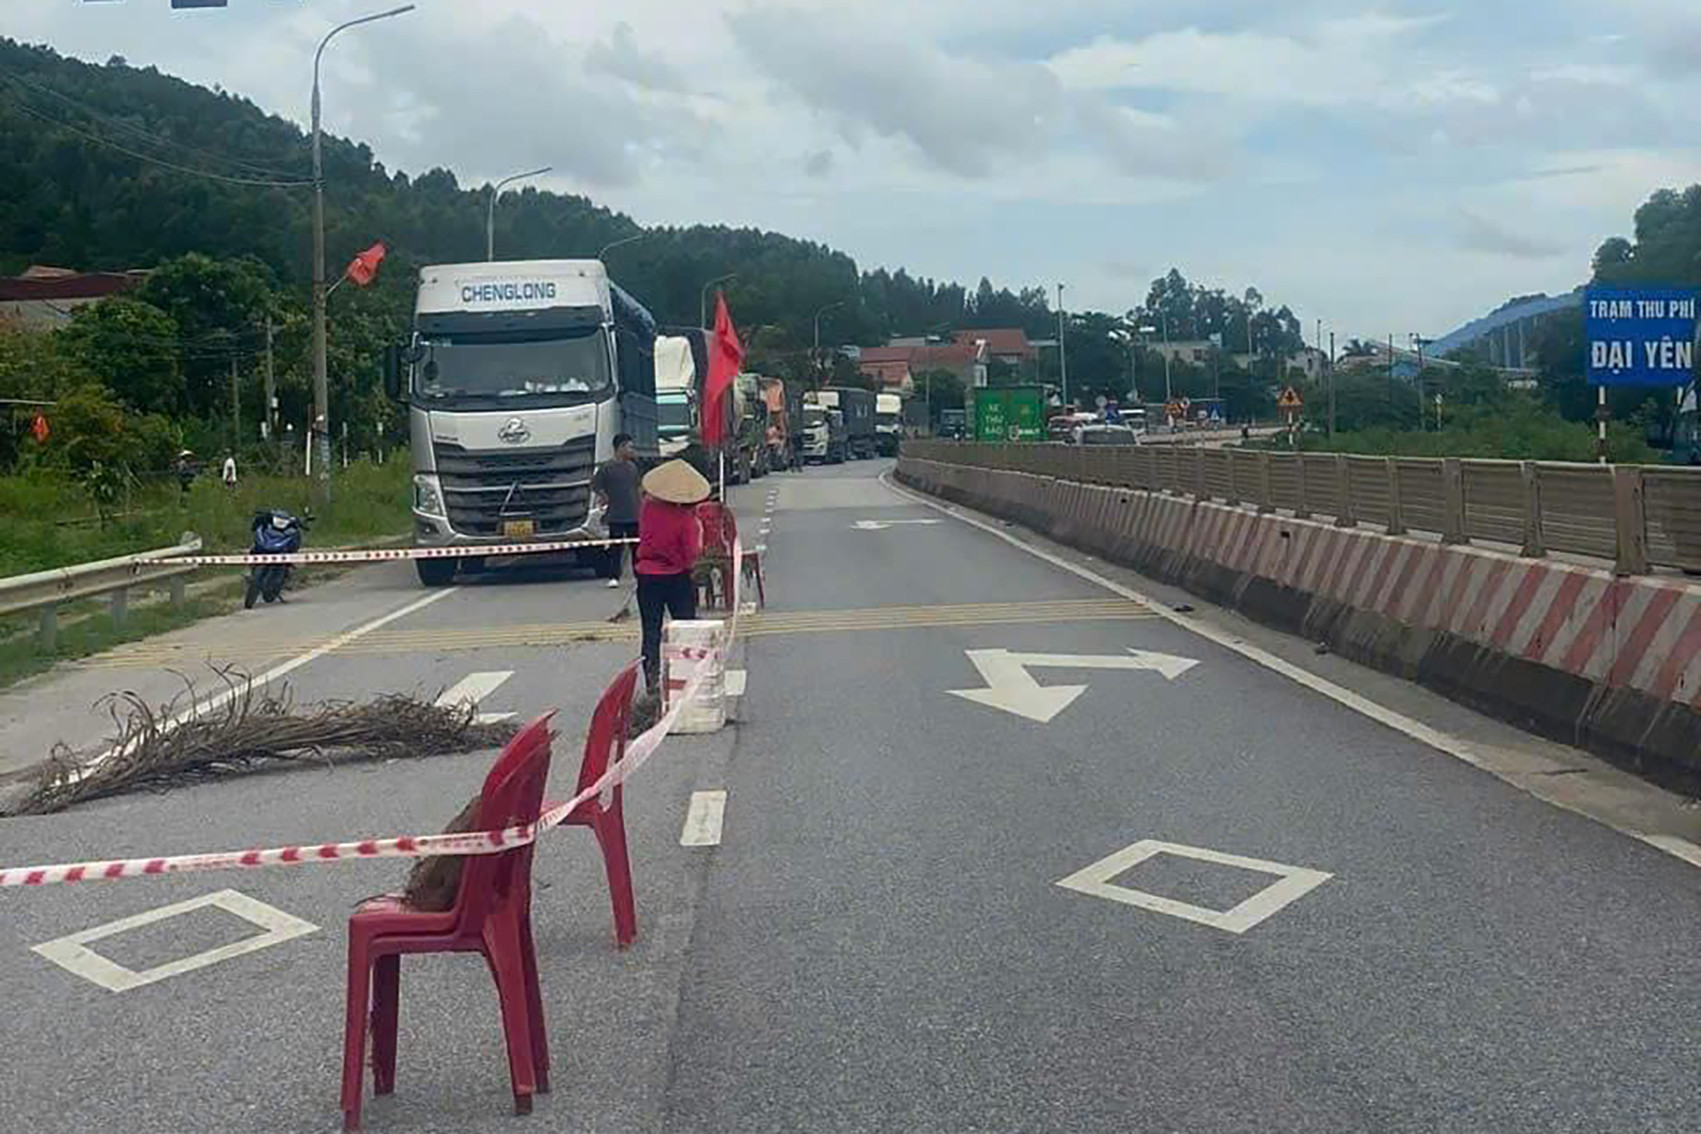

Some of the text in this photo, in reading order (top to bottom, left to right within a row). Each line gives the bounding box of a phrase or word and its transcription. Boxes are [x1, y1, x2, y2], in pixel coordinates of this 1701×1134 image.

[461, 282, 556, 303] CHENGLONG
[1590, 298, 1695, 323] TRẠM THU PHÍ
[1591, 335, 1692, 374] ĐẠI YÊN
